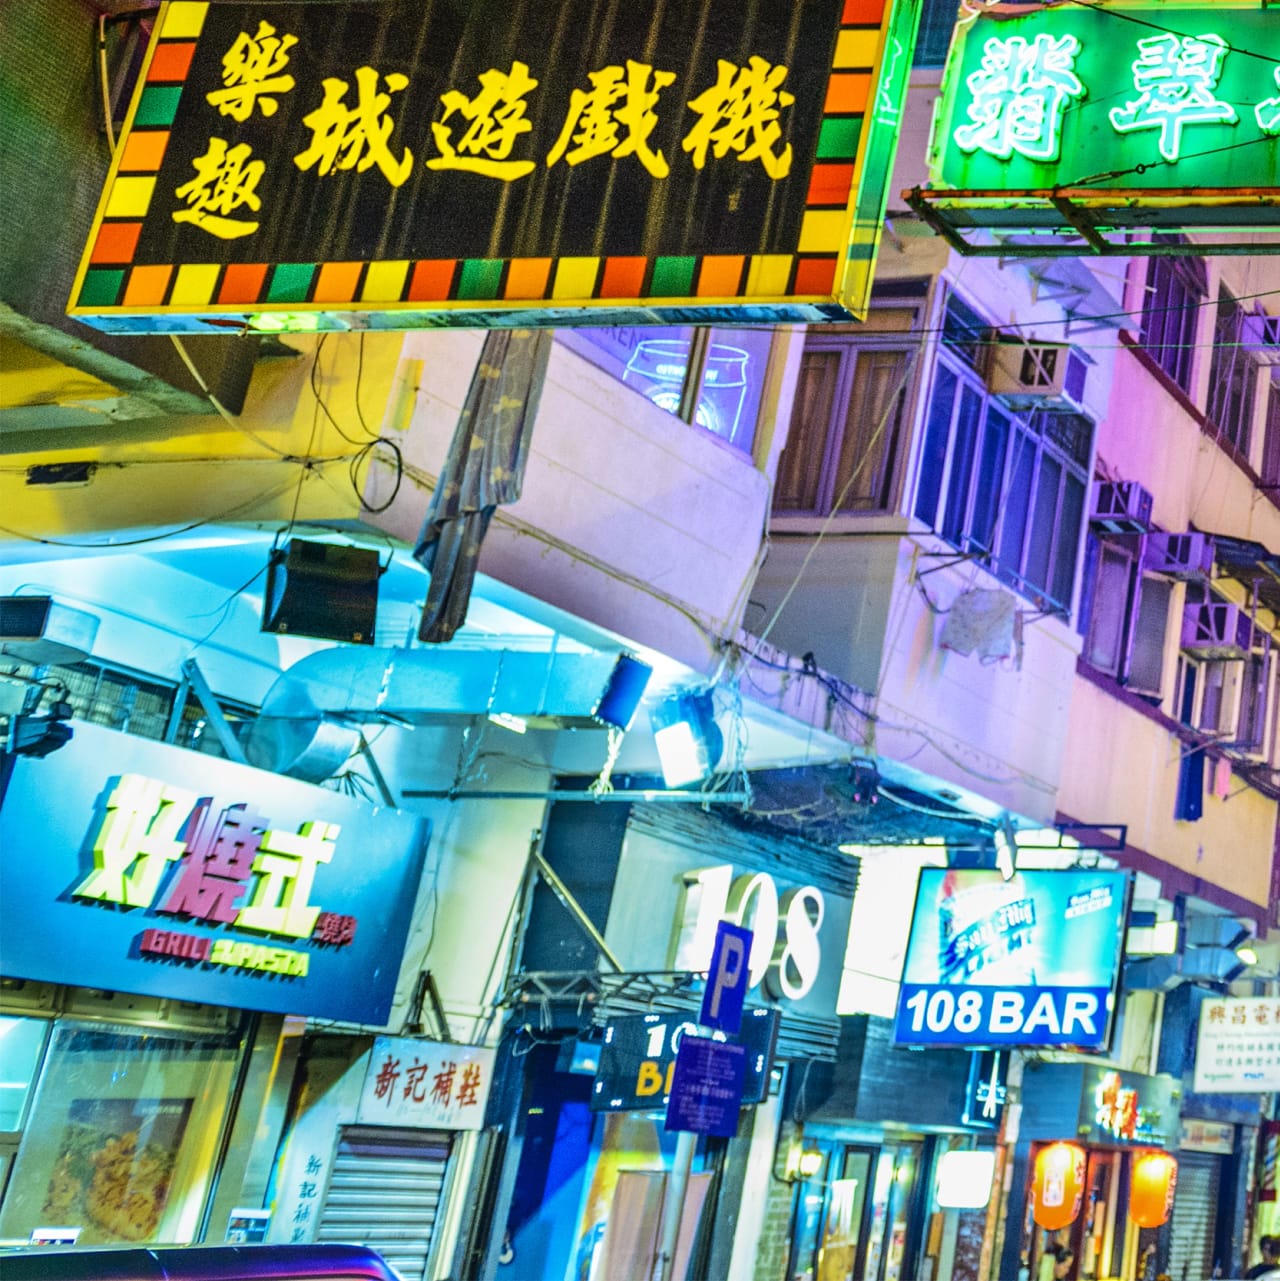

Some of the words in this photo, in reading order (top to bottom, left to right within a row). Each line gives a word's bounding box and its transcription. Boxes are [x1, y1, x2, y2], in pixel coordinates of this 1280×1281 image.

[675, 865, 824, 1001] 108
[709, 934, 746, 1018] P
[906, 989, 984, 1033] 108
[988, 991, 1099, 1035] BAR
